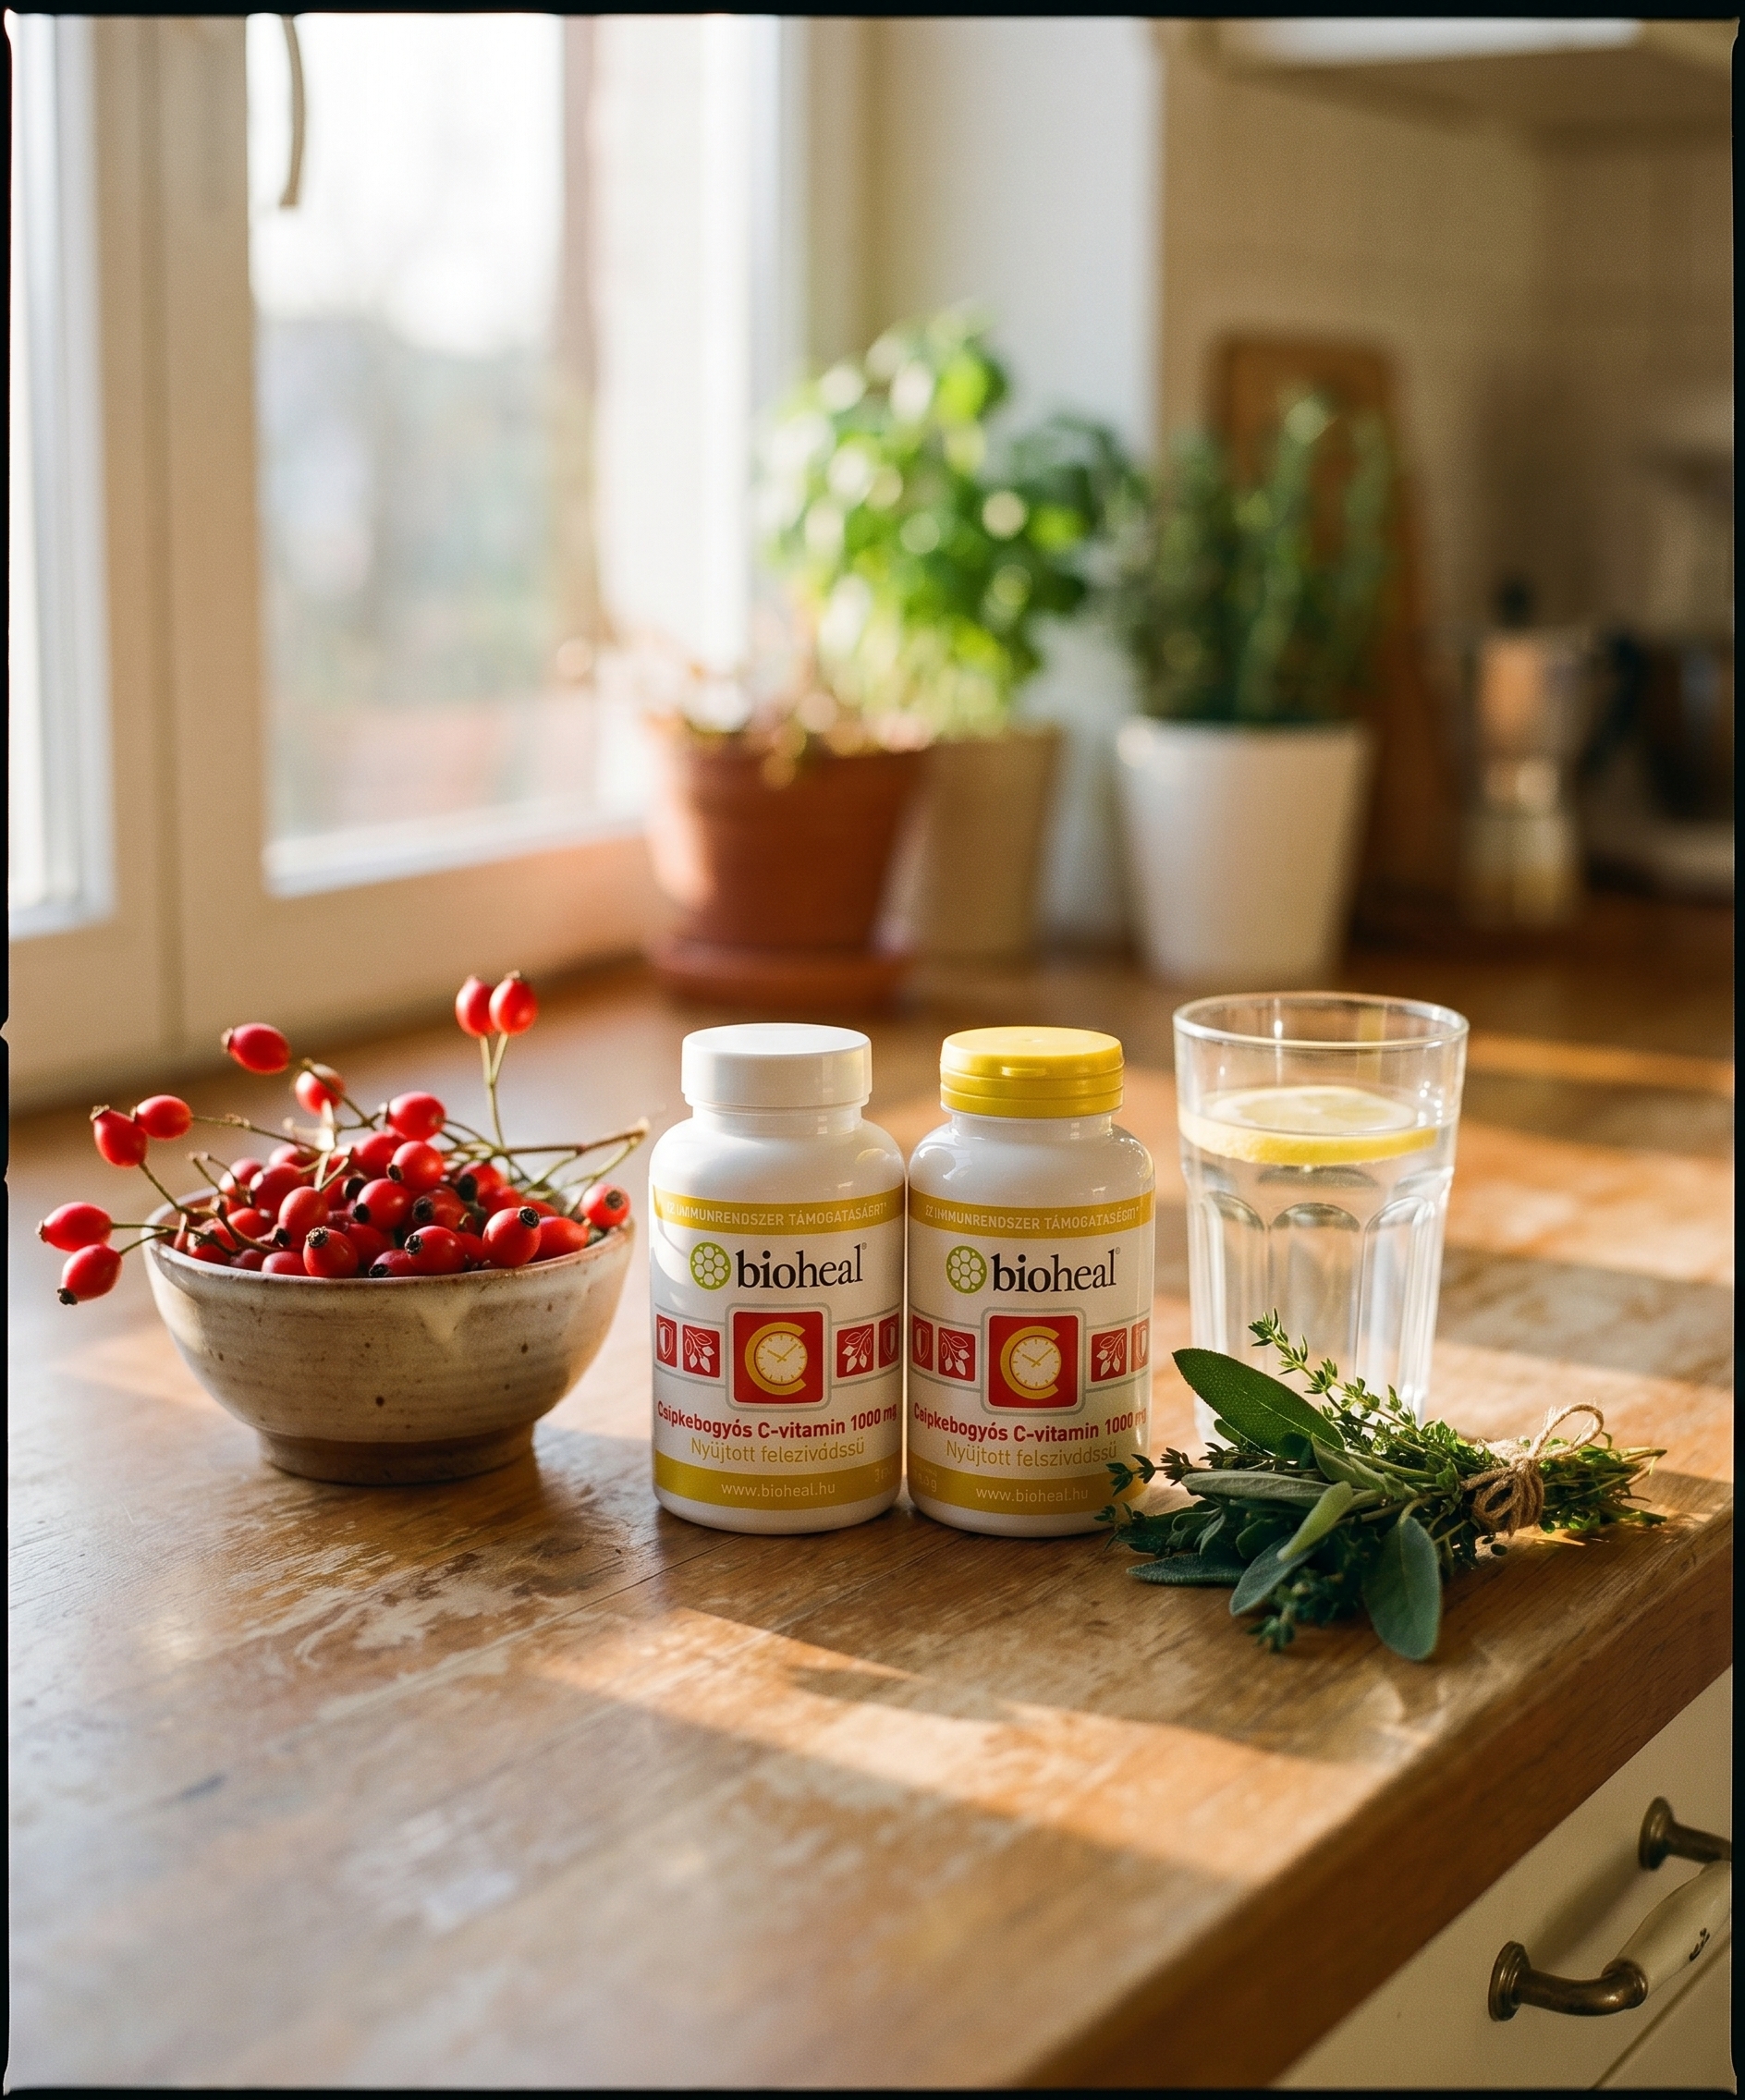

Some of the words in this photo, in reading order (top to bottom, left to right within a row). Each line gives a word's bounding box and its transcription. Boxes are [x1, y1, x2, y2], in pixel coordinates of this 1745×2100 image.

[657, 1400, 753, 1440] Csipkebogyós
[758, 1418, 846, 1439] C-vitamin
[850, 1407, 881, 1432] 1000
[883, 1403, 897, 1422] mg
[1013, 1422, 1099, 1443] C-vitamin
[1104, 1411, 1133, 1435] 1000
[721, 1482, 836, 1498] www.bioheal.hu
[975, 1487, 1089, 1503] www.bioheal.hu
